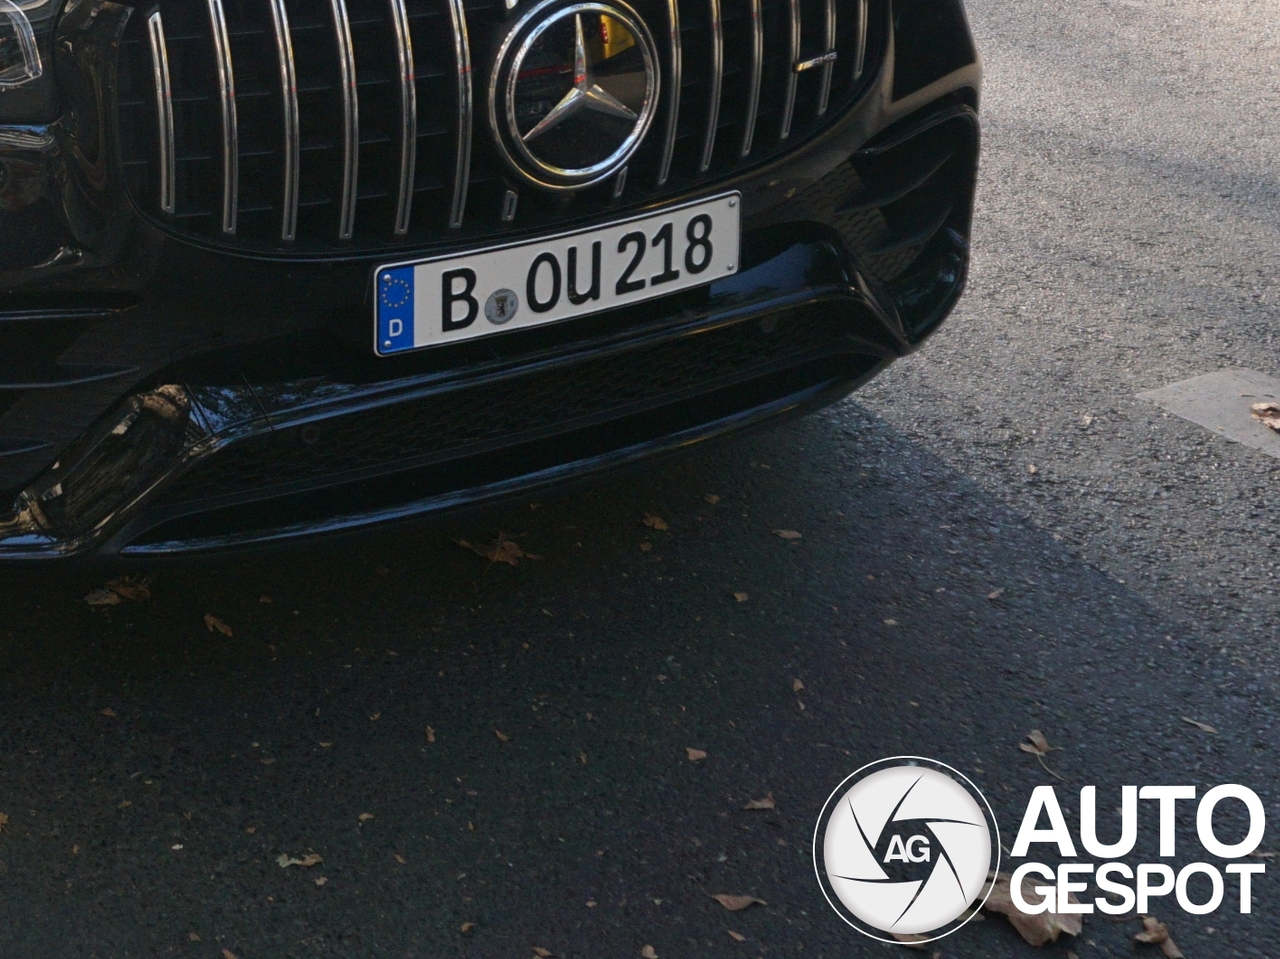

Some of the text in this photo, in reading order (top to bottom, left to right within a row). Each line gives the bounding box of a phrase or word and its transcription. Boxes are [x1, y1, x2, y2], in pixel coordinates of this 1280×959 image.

[389, 319, 404, 338] D
[441, 267, 479, 332] B
[526, 241, 602, 314] OU
[615, 213, 714, 296] 218
